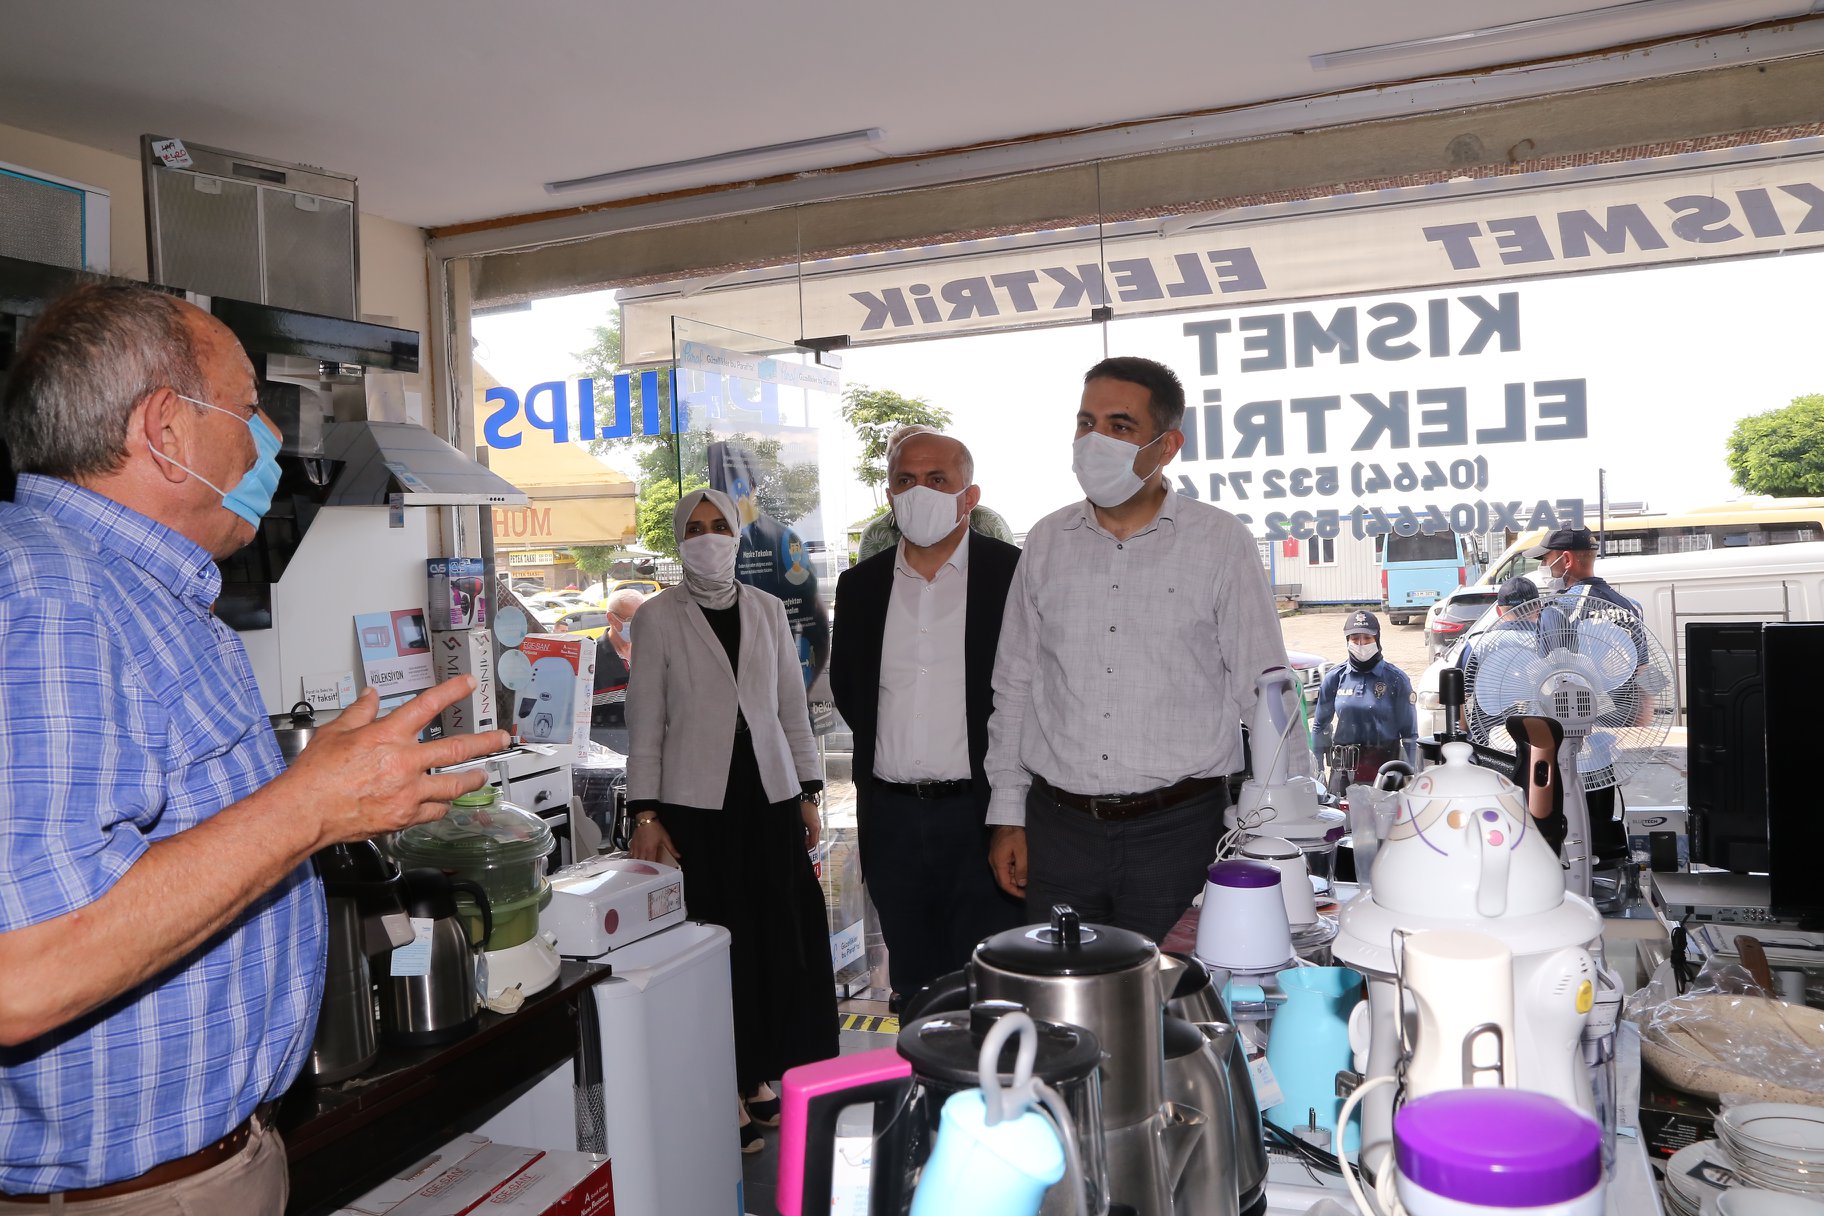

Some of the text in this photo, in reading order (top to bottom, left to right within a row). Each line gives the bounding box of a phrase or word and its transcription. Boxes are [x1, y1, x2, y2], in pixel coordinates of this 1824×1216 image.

[307, 692, 338, 703] +7 taksit!
[1336, 688, 1354, 696] OLIS
[812, 701, 832, 714] beko
